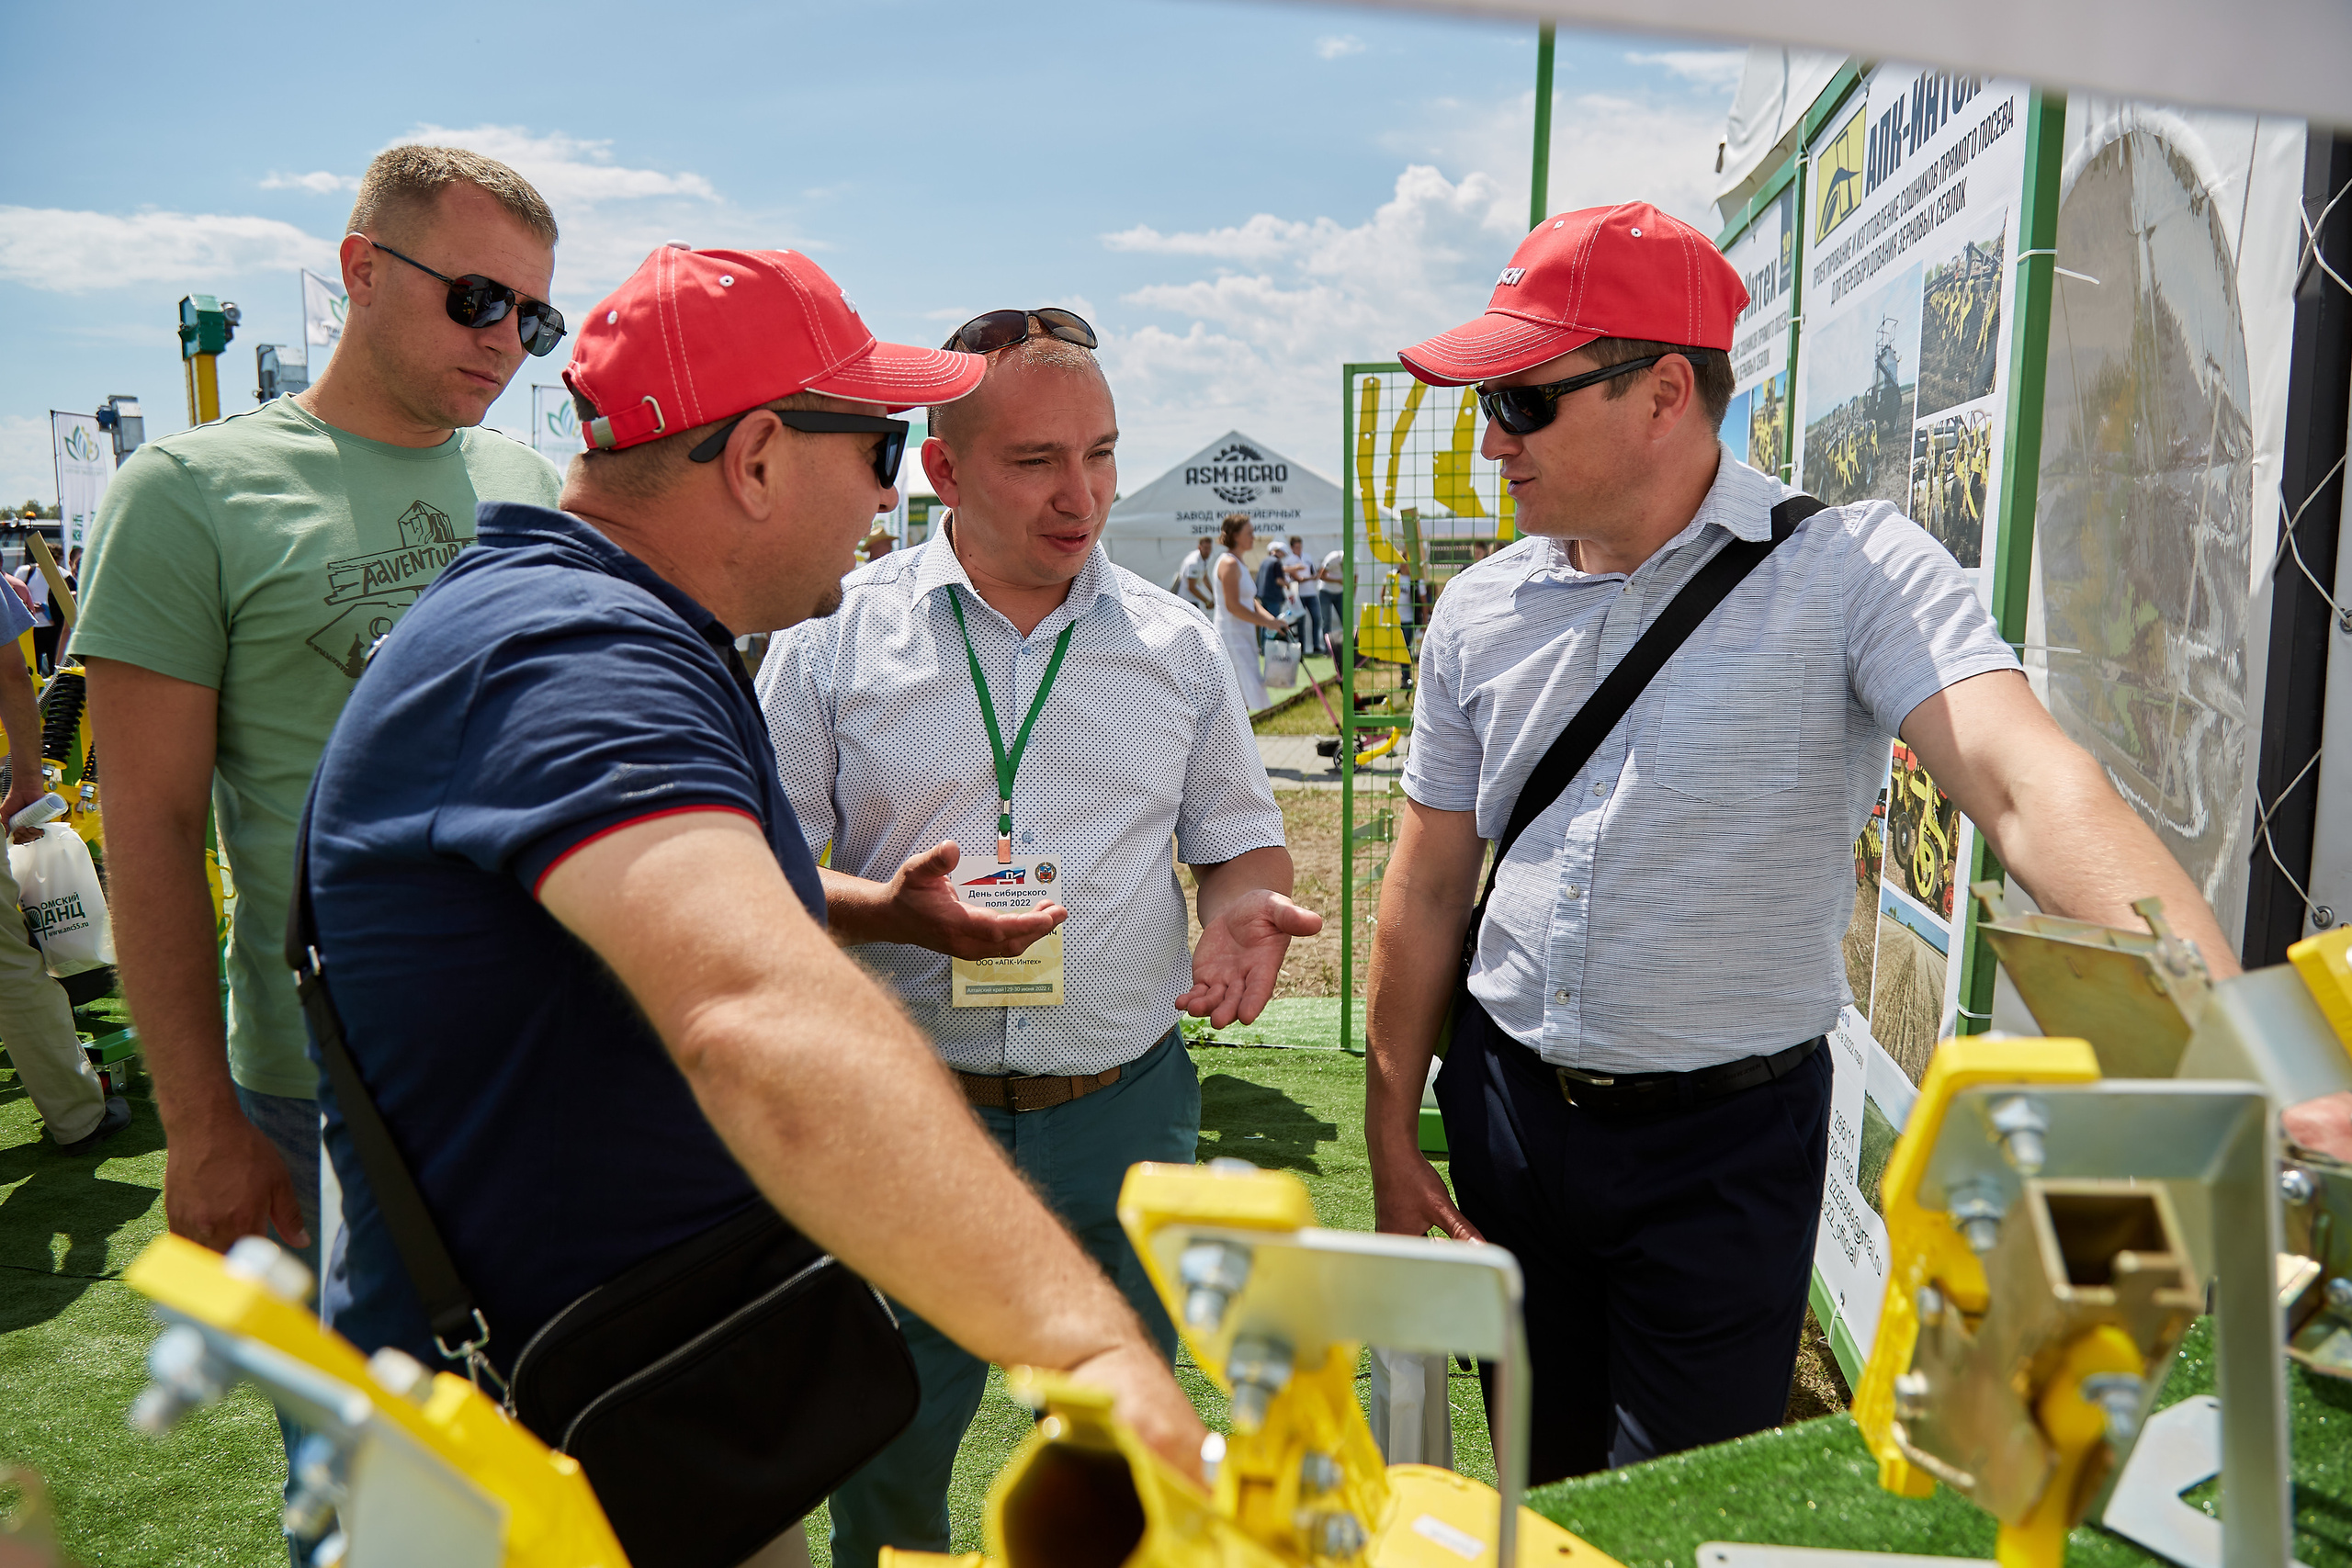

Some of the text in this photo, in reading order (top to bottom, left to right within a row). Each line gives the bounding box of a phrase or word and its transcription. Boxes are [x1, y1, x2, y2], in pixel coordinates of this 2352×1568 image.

[1856, 195, 1900, 254] ИЗГОТОВЛЕНИЕ
[1900, 160, 1939, 218] СОШНИКОВ
[1939, 127, 1977, 186] ПРЯМОГО
[1978, 95, 2015, 154] ПОСЕВА
[1898, 201, 1936, 255] ЗЕРНОВЫХ
[1936, 176, 1968, 228] СЕЯЛОК
[1176, 510, 1215, 522] ЗАВОД
[40, 891, 80, 910] ОМСКИЙ
[968, 888, 1047, 898] День сибирского
[1010, 898, 1031, 908] 2022
[45, 901, 86, 926] АНЦ
[48, 920, 89, 937] www.anc55.ru
